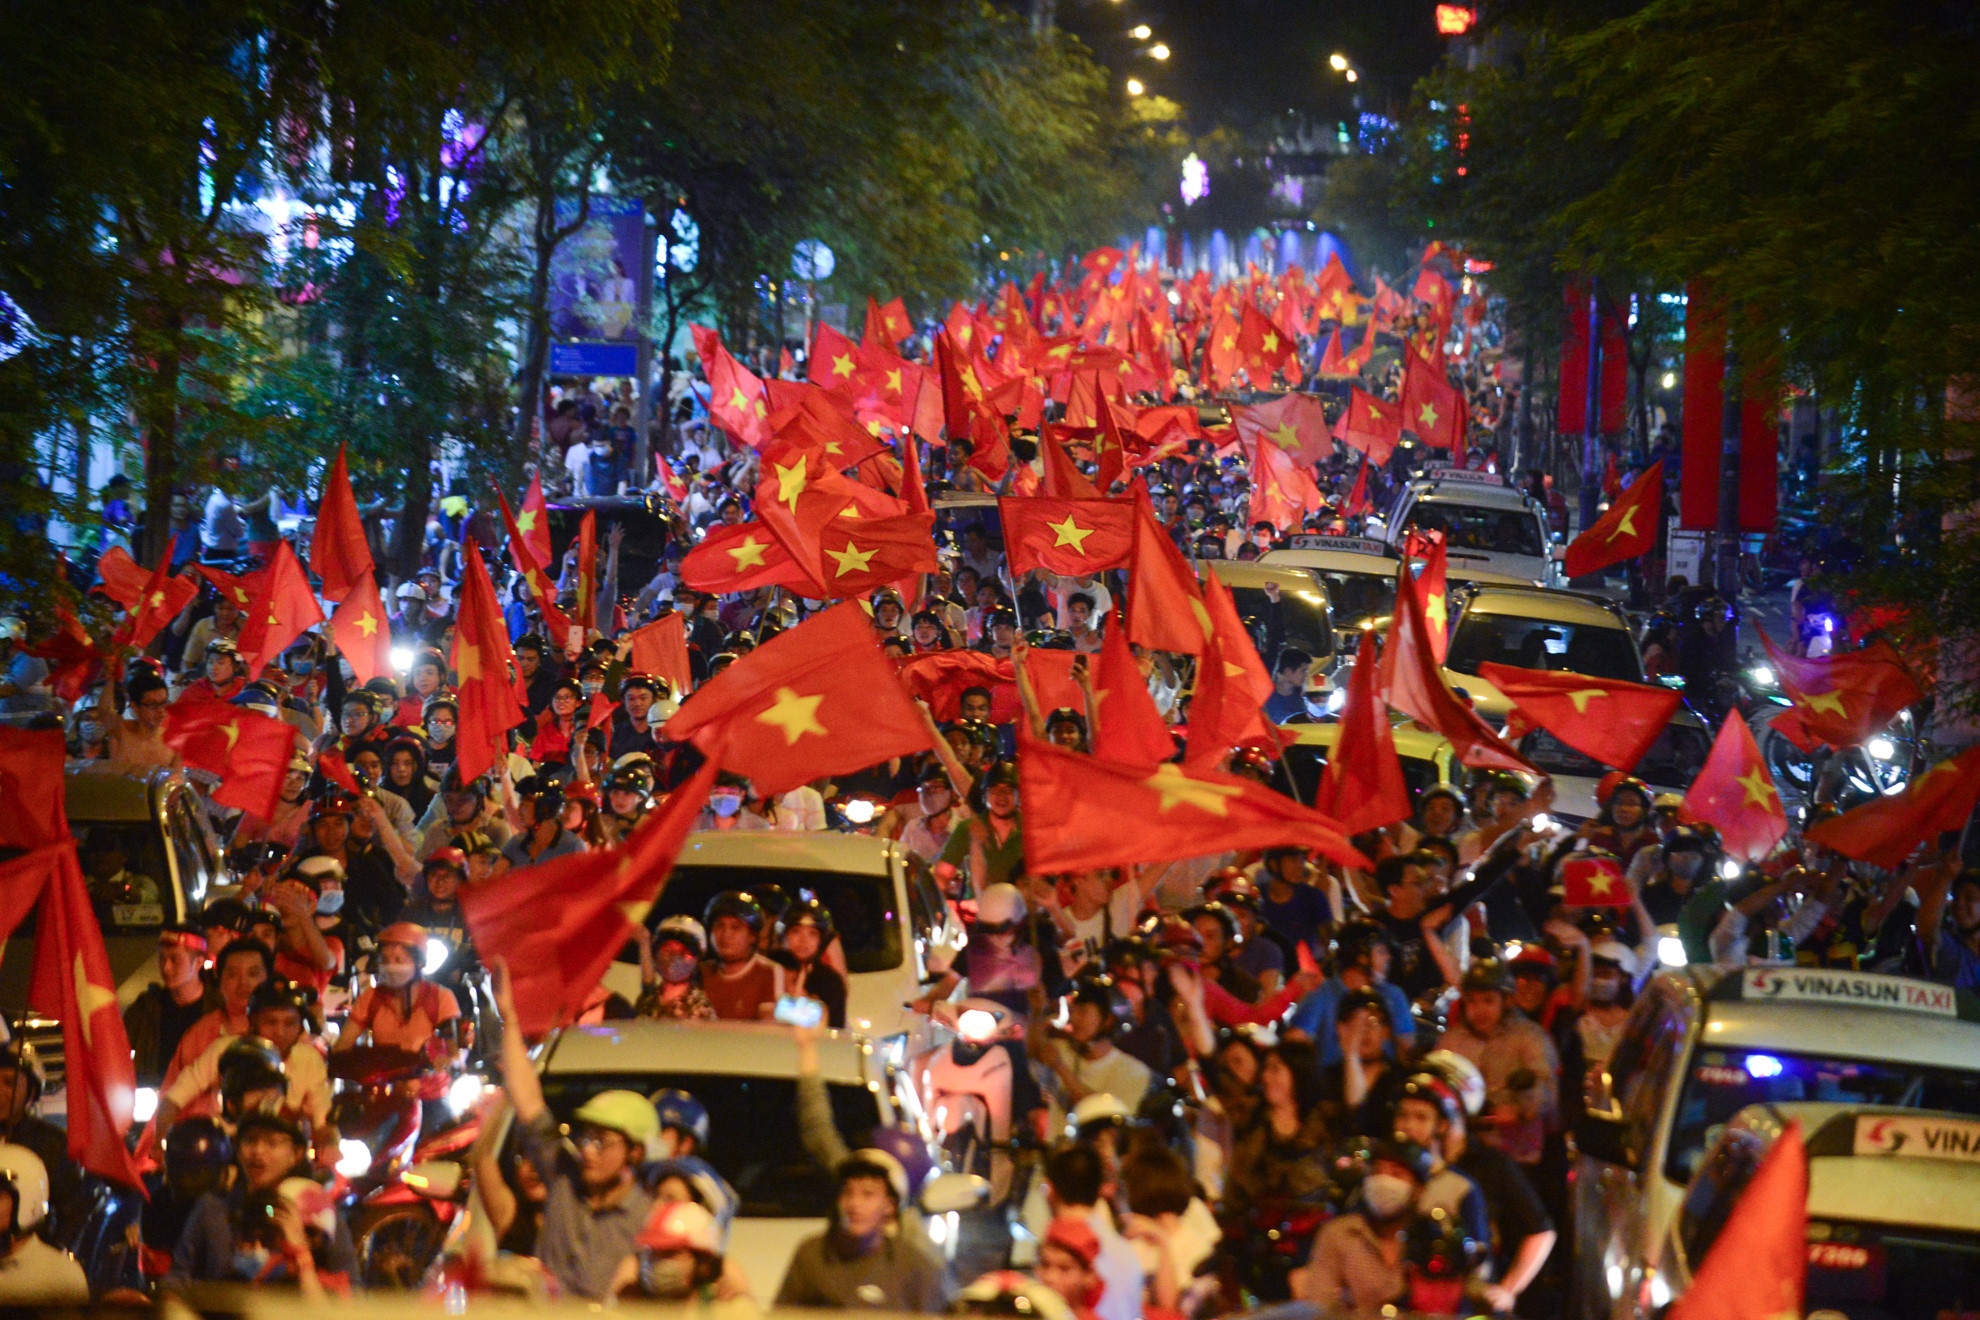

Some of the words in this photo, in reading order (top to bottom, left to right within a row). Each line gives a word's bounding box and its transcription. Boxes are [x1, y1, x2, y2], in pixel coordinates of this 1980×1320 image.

[1314, 539, 1359, 549] VINASUN
[1361, 541, 1382, 552] TAXI
[1794, 975, 1899, 1001] VINASUN
[1904, 985, 1950, 1009] TAXI
